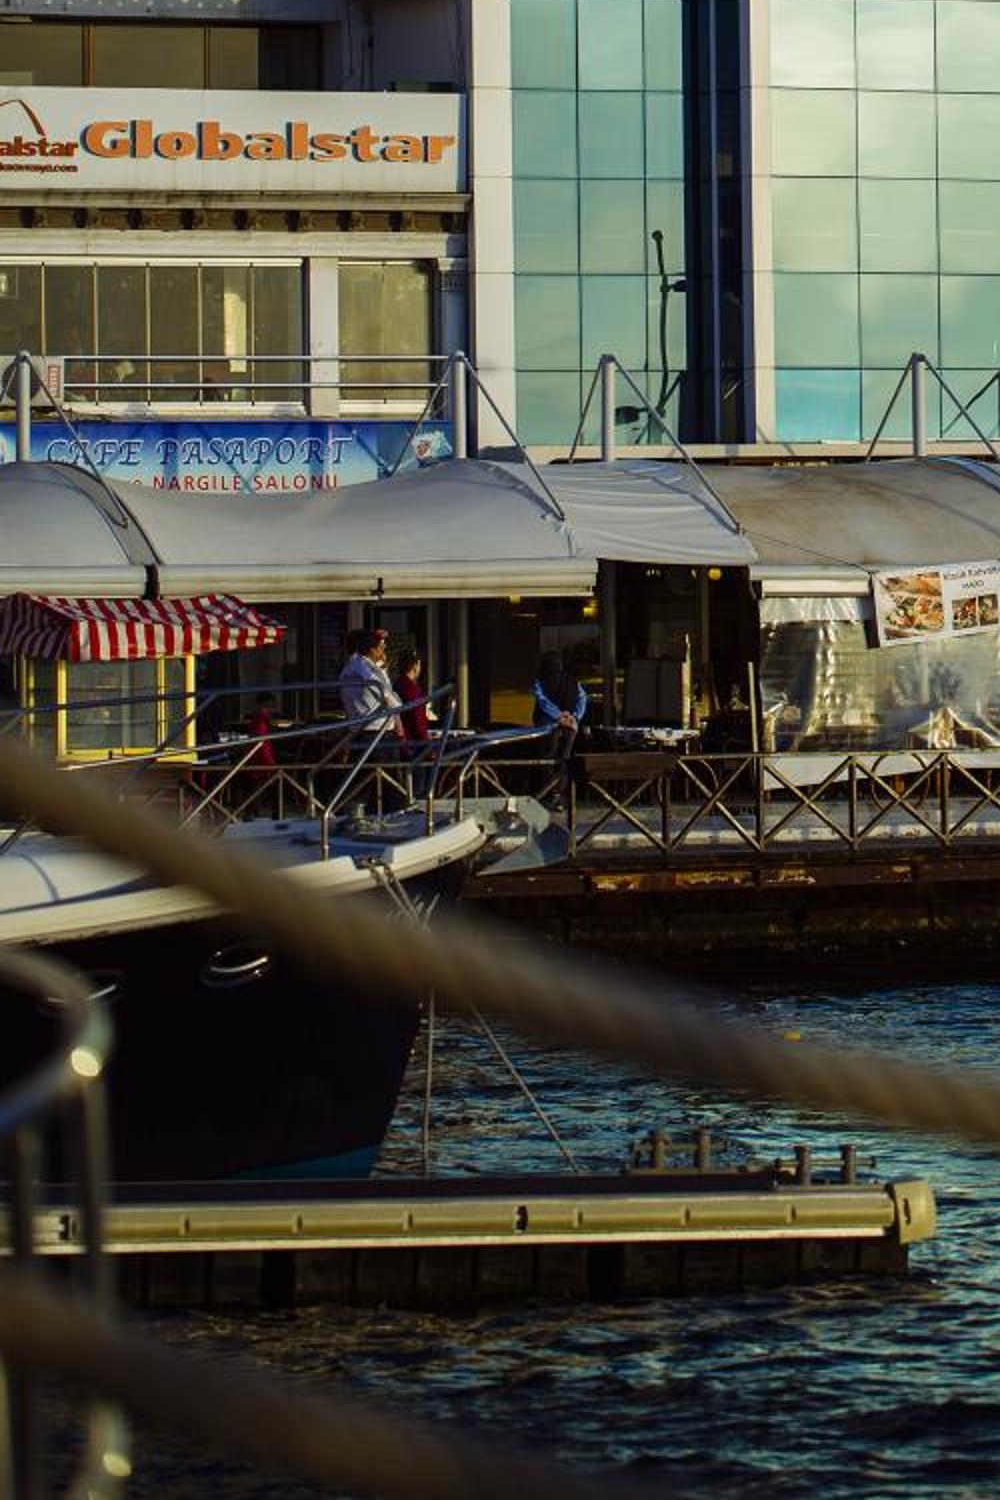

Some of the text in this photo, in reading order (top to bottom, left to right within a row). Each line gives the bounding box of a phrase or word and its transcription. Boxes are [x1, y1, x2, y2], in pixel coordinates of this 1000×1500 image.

[81, 119, 456, 164] Globalstar
[48, 437, 353, 467] CAFE PASAPORT
[253, 474, 338, 491] SALONU
